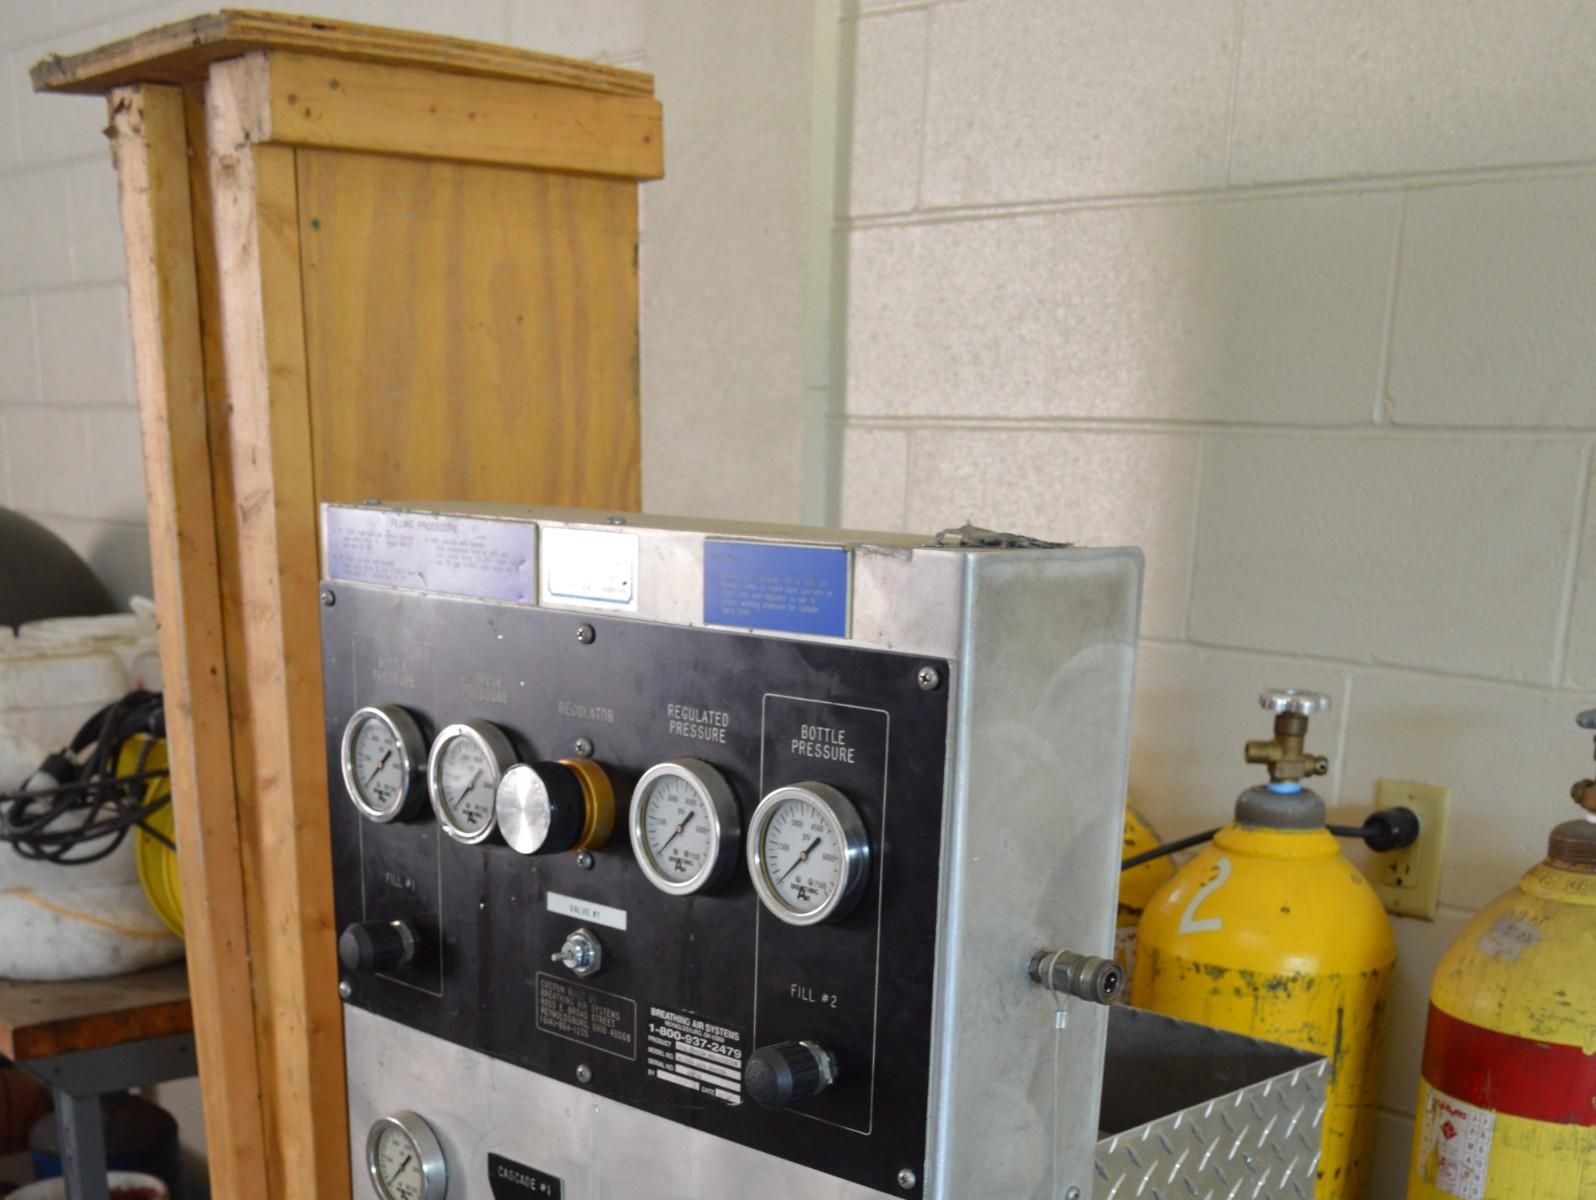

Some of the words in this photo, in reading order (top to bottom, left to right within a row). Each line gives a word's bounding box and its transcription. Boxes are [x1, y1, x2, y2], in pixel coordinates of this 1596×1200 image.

[557, 700, 615, 723] REGULATOR
[666, 703, 729, 728] REGULATED
[669, 720, 727, 744] PRESSURE
[801, 724, 846, 746] BOTTLE
[791, 739, 855, 764] PRESSURE
[1178, 857, 1232, 935] 2
[790, 983, 816, 1003] FILL
[821, 993, 838, 1009] #2
[650, 1006, 691, 1026] BREATHING
[691, 1019, 704, 1030] AIR
[705, 1023, 740, 1041] SYSTEMS
[648, 1023, 742, 1059] 1-800-937-2479
[498, 1165, 536, 1191] CASCADE
[540, 1183, 551, 1197] #1
